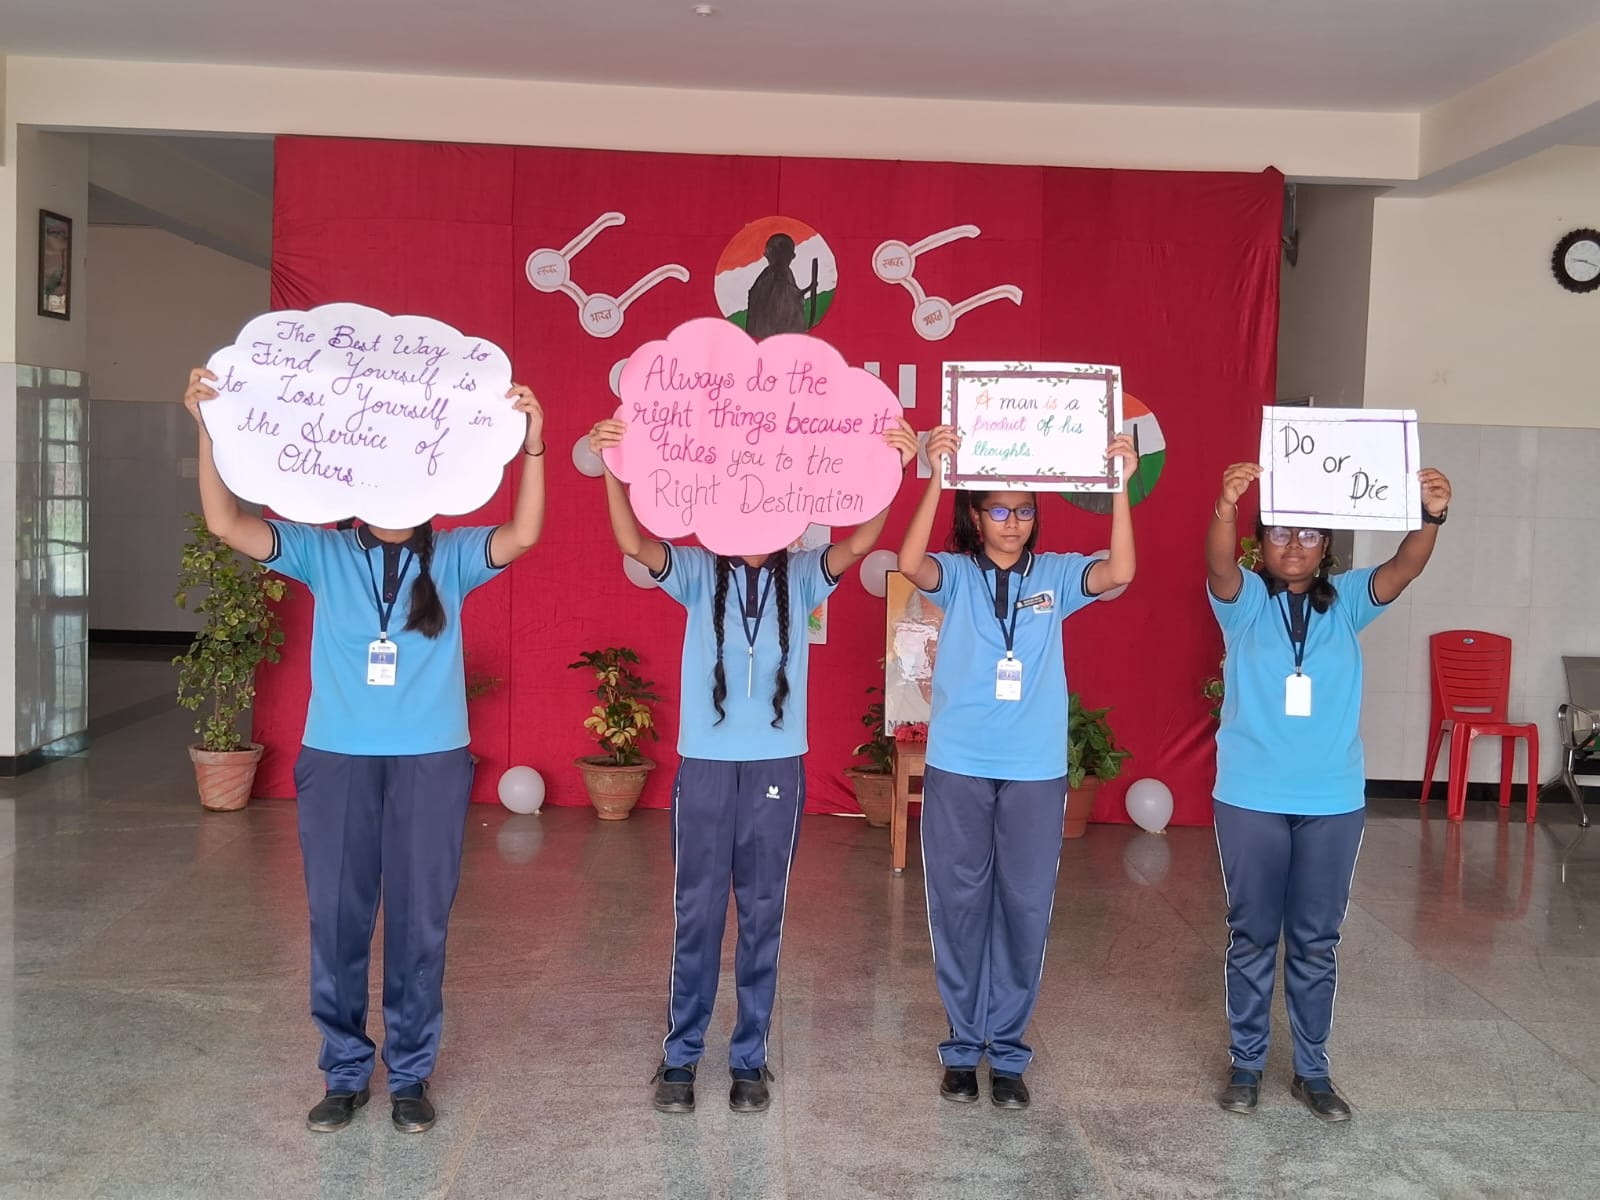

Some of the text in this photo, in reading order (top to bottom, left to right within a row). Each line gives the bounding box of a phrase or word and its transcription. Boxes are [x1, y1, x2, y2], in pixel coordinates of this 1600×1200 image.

[590, 309, 612, 323] भारत
[276, 320, 492, 367] The Best Way to
[252, 341, 477, 400] Find Yourself is
[644, 354, 735, 401] Always
[746, 358, 778, 392] do
[786, 360, 827, 396] the
[217, 365, 247, 393] to
[345, 382, 449, 433] Yourself
[468, 409, 494, 427] in
[631, 399, 893, 445] right things because it
[974, 389, 1080, 410] A man is a
[237, 408, 450, 476] the Service of
[971, 415, 1084, 437] product of his
[1279, 422, 1315, 463] Do
[656, 431, 843, 477] takes you to the
[1322, 455, 1351, 473] or
[648, 468, 864, 526] Right Destination
[1349, 467, 1388, 508] Die
